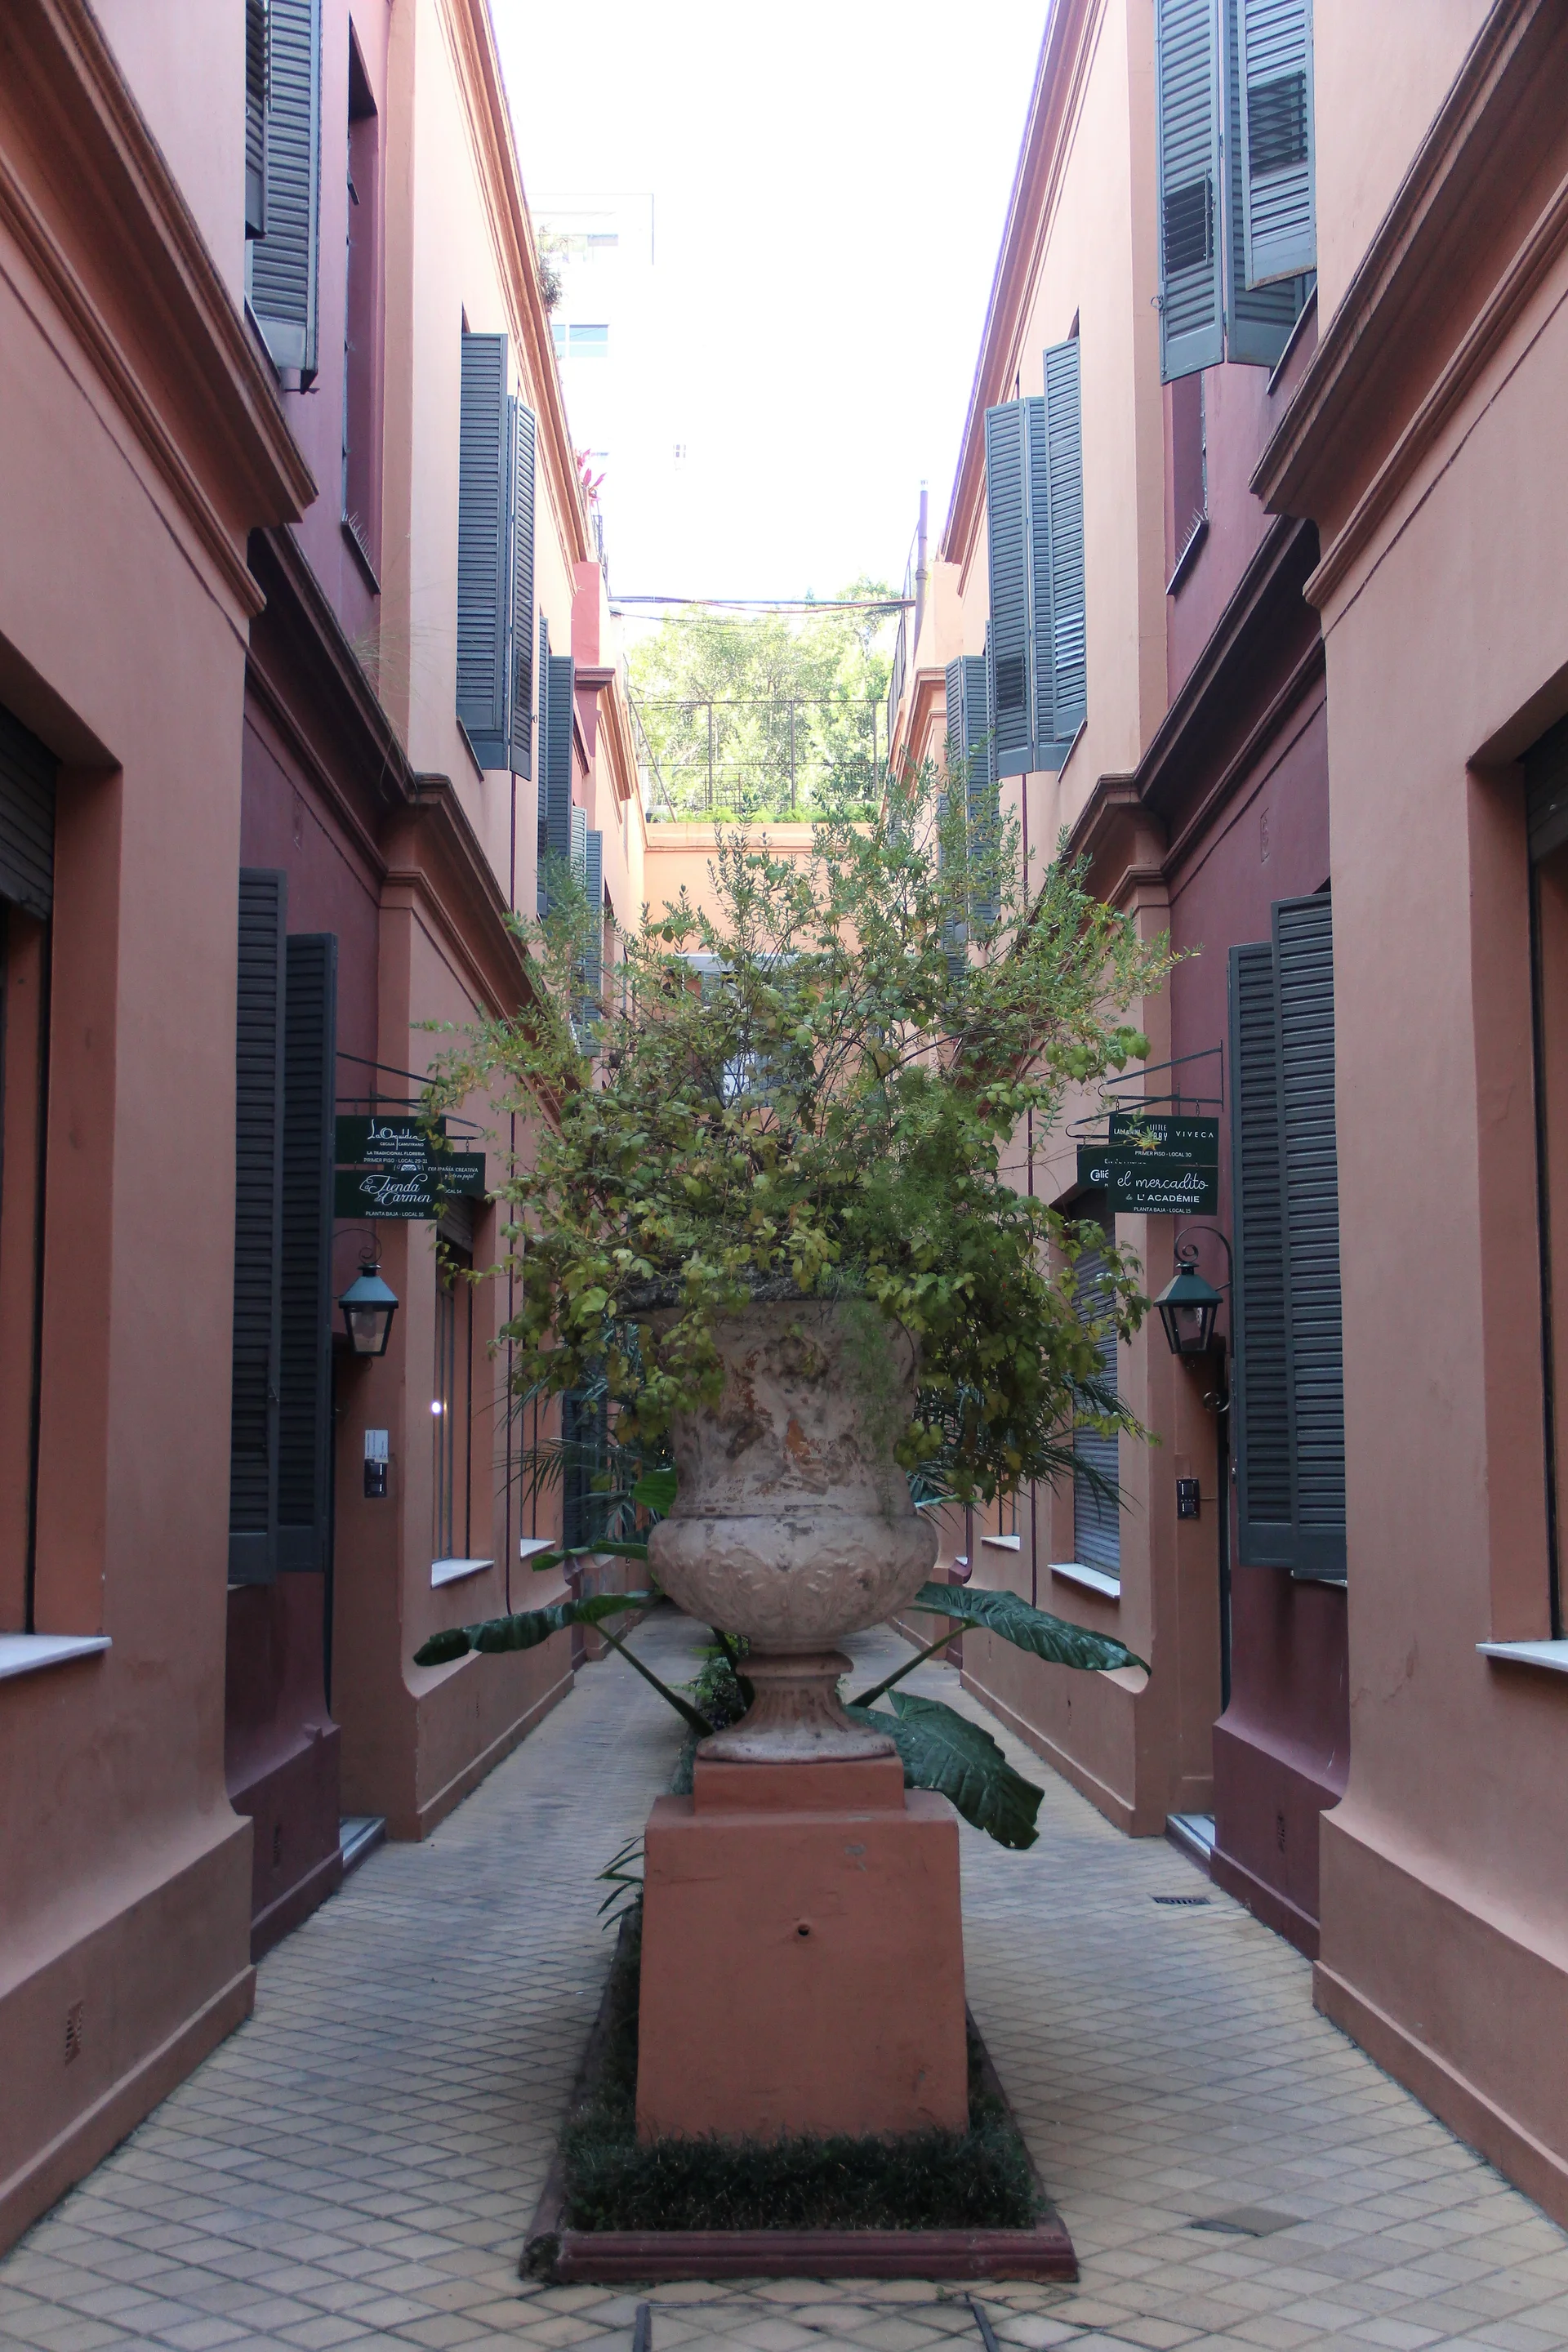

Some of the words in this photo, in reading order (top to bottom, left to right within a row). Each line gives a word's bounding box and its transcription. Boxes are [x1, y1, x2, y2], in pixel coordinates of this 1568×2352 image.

[368, 1119, 381, 1139] La
[366, 1174, 428, 1194] Tienda
[1117, 1170, 1132, 1187] el
[1135, 1173, 1209, 1190] mercadito
[381, 1192, 433, 1205] Carmen
[1147, 1194, 1200, 1203] ACADÉMIE
